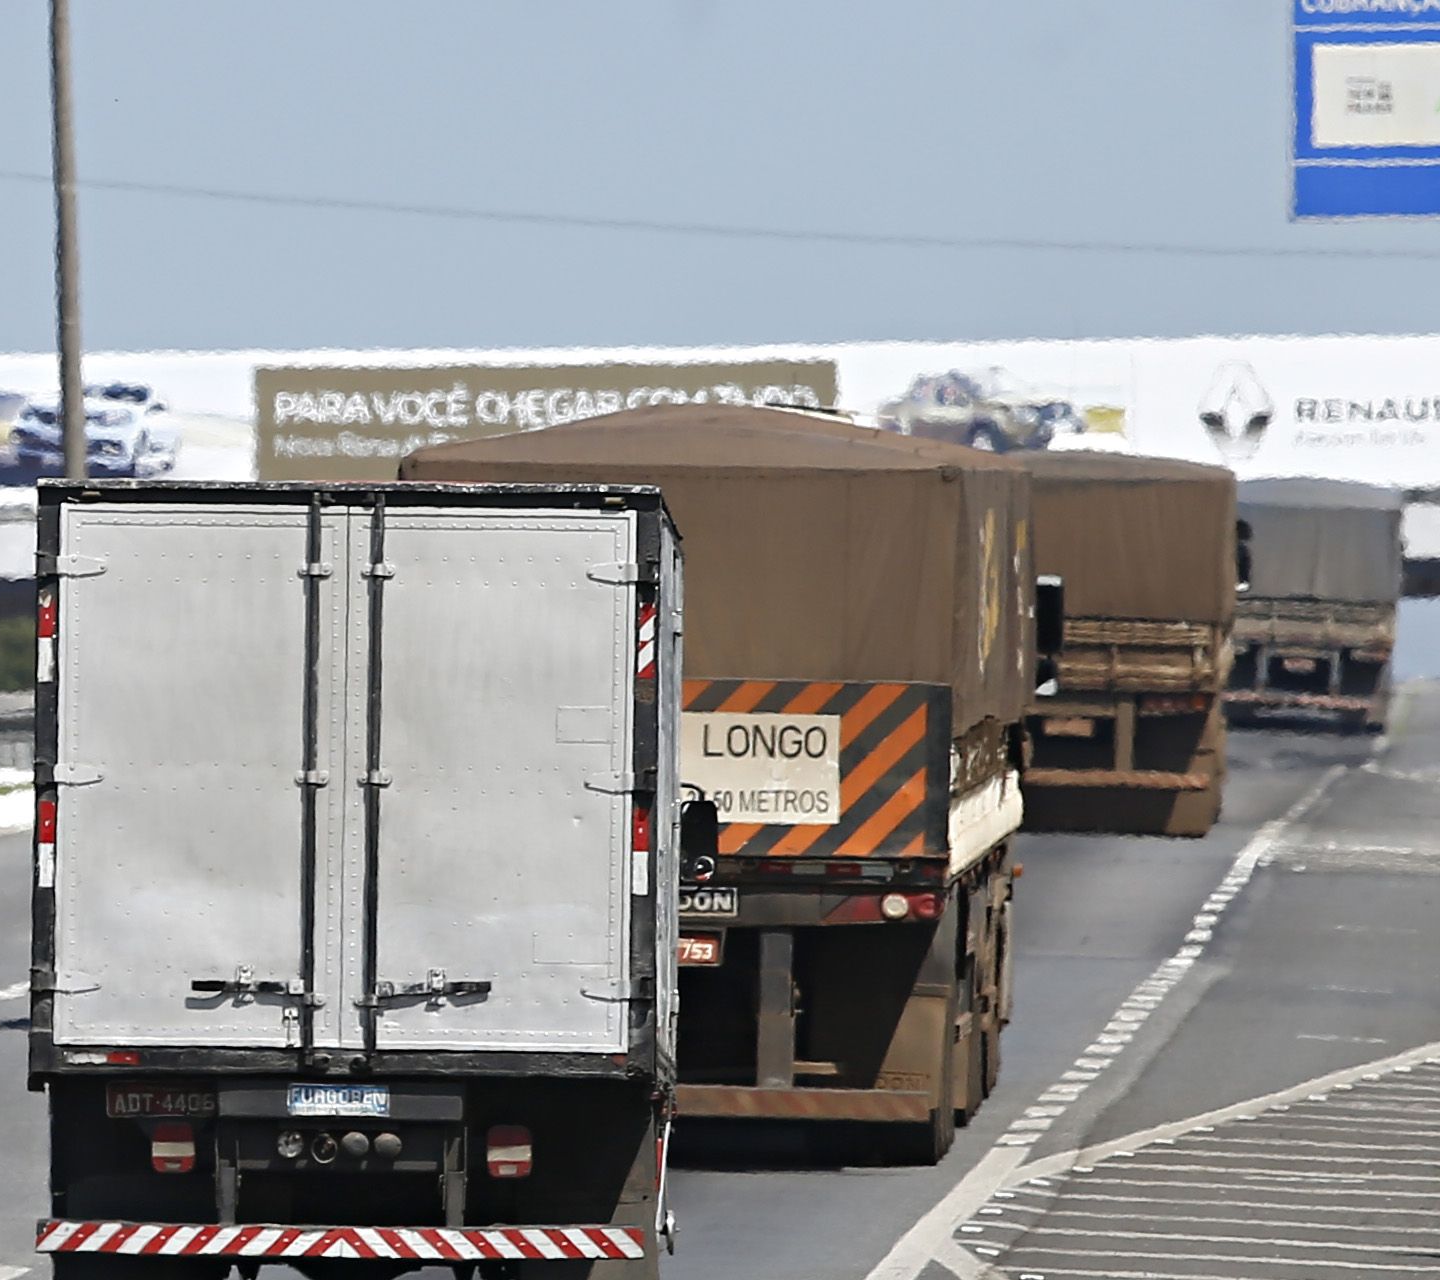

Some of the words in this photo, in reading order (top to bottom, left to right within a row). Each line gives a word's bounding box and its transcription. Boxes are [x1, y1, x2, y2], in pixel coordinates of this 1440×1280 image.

[273, 390, 371, 427] PARA
[372, 380, 469, 427] VOCÊ
[475, 386, 623, 431] CHEGAR
[702, 724, 828, 760] LONGO
[739, 789, 829, 814] METROS
